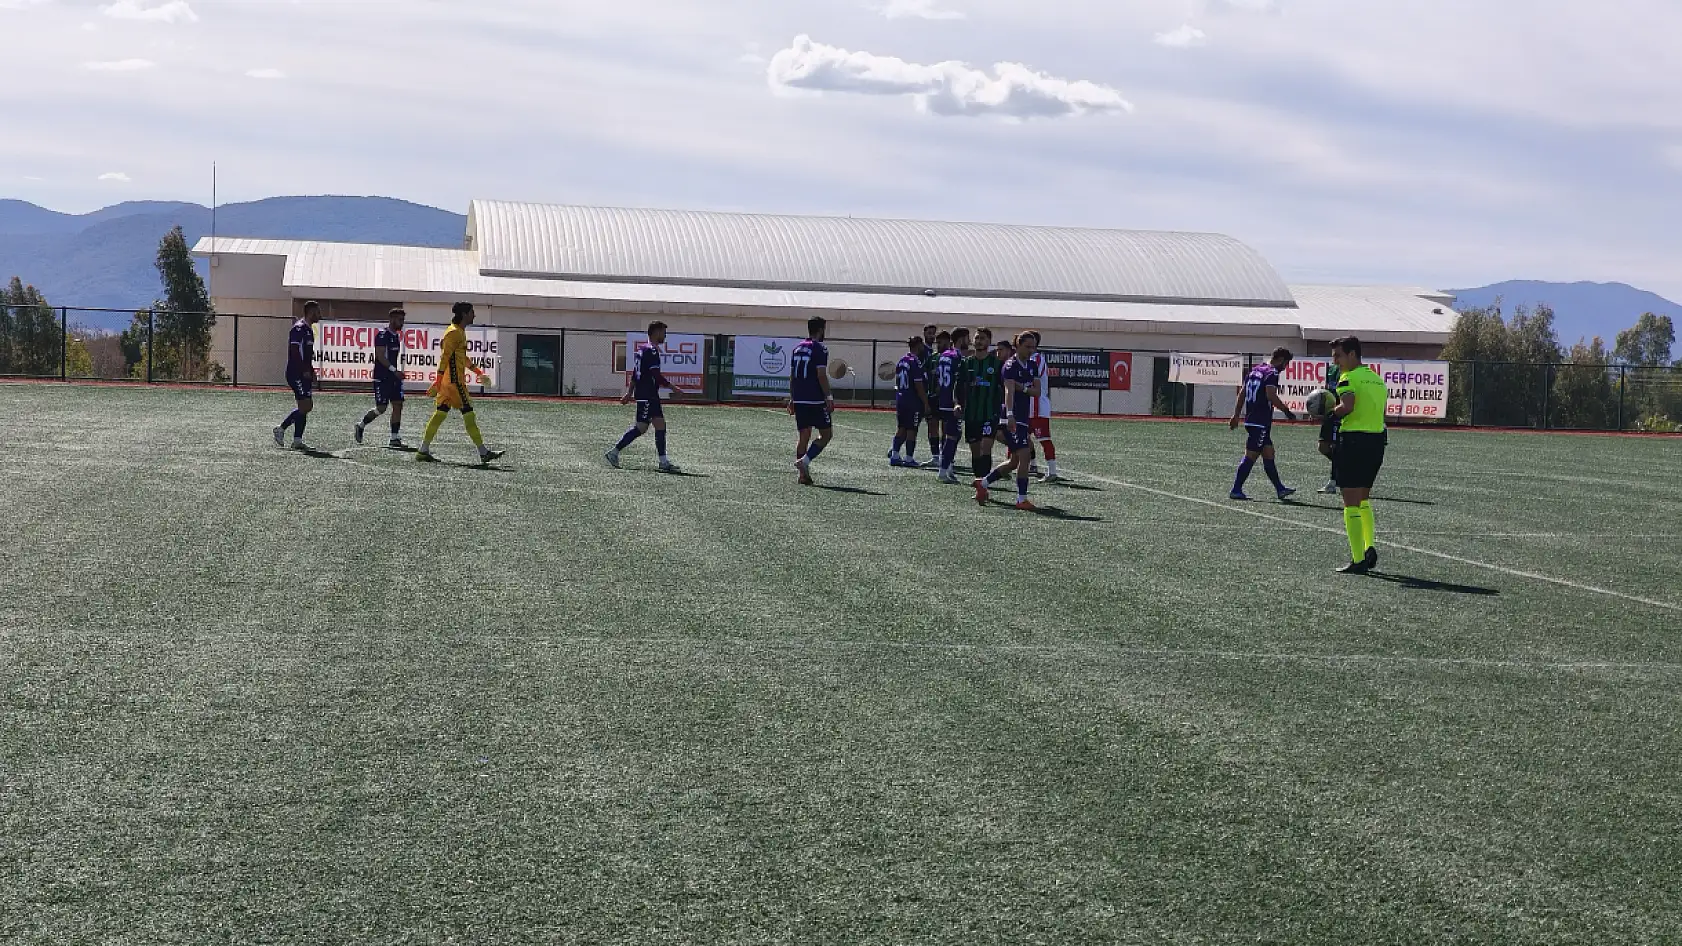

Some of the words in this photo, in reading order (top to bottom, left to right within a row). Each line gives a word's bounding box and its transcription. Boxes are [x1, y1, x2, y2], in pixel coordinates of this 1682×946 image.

[400, 354, 437, 367] FUTBOL
[1384, 372, 1445, 386] FERFORJE
[1409, 387, 1443, 401] DİLERİZ
